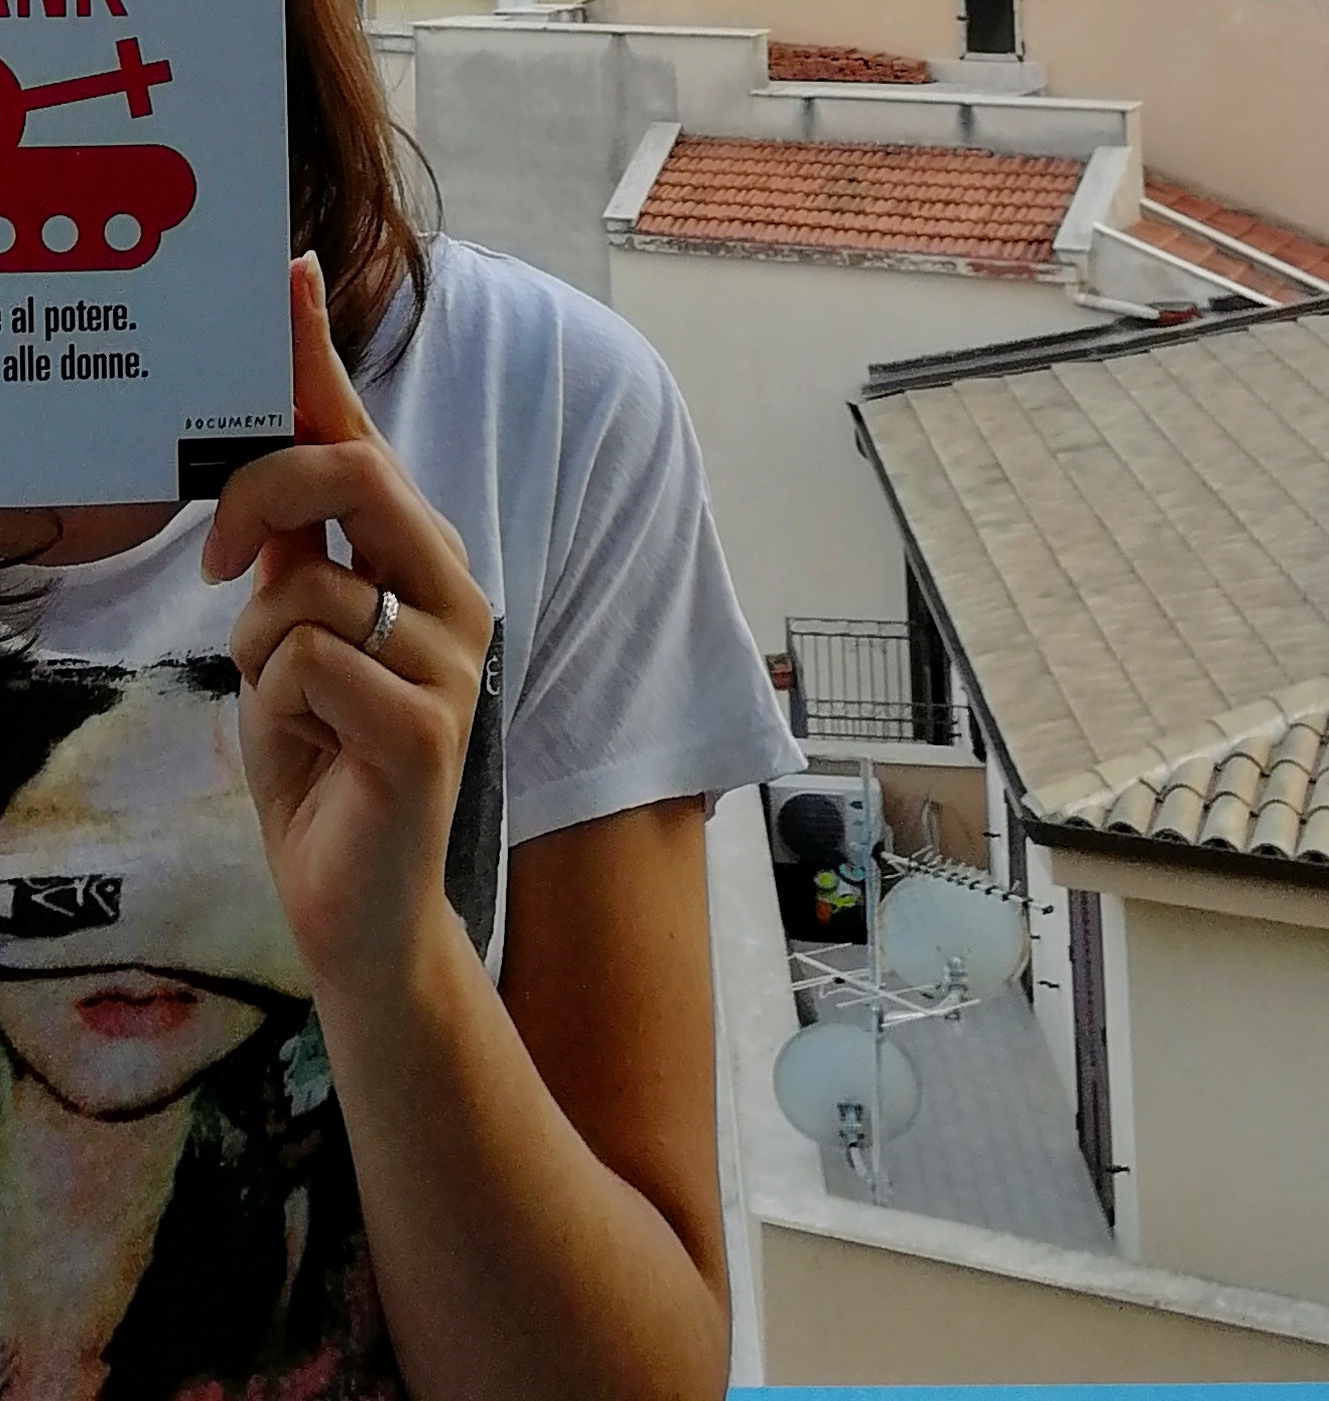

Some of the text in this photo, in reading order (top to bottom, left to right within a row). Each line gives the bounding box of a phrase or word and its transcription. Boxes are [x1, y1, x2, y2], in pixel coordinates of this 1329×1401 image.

[11, 296, 35, 334] al
[44, 299, 137, 342] potere.
[3, 344, 51, 383] alle
[60, 343, 149, 381] donne.
[184, 413, 284, 430] DOCUMENTI
